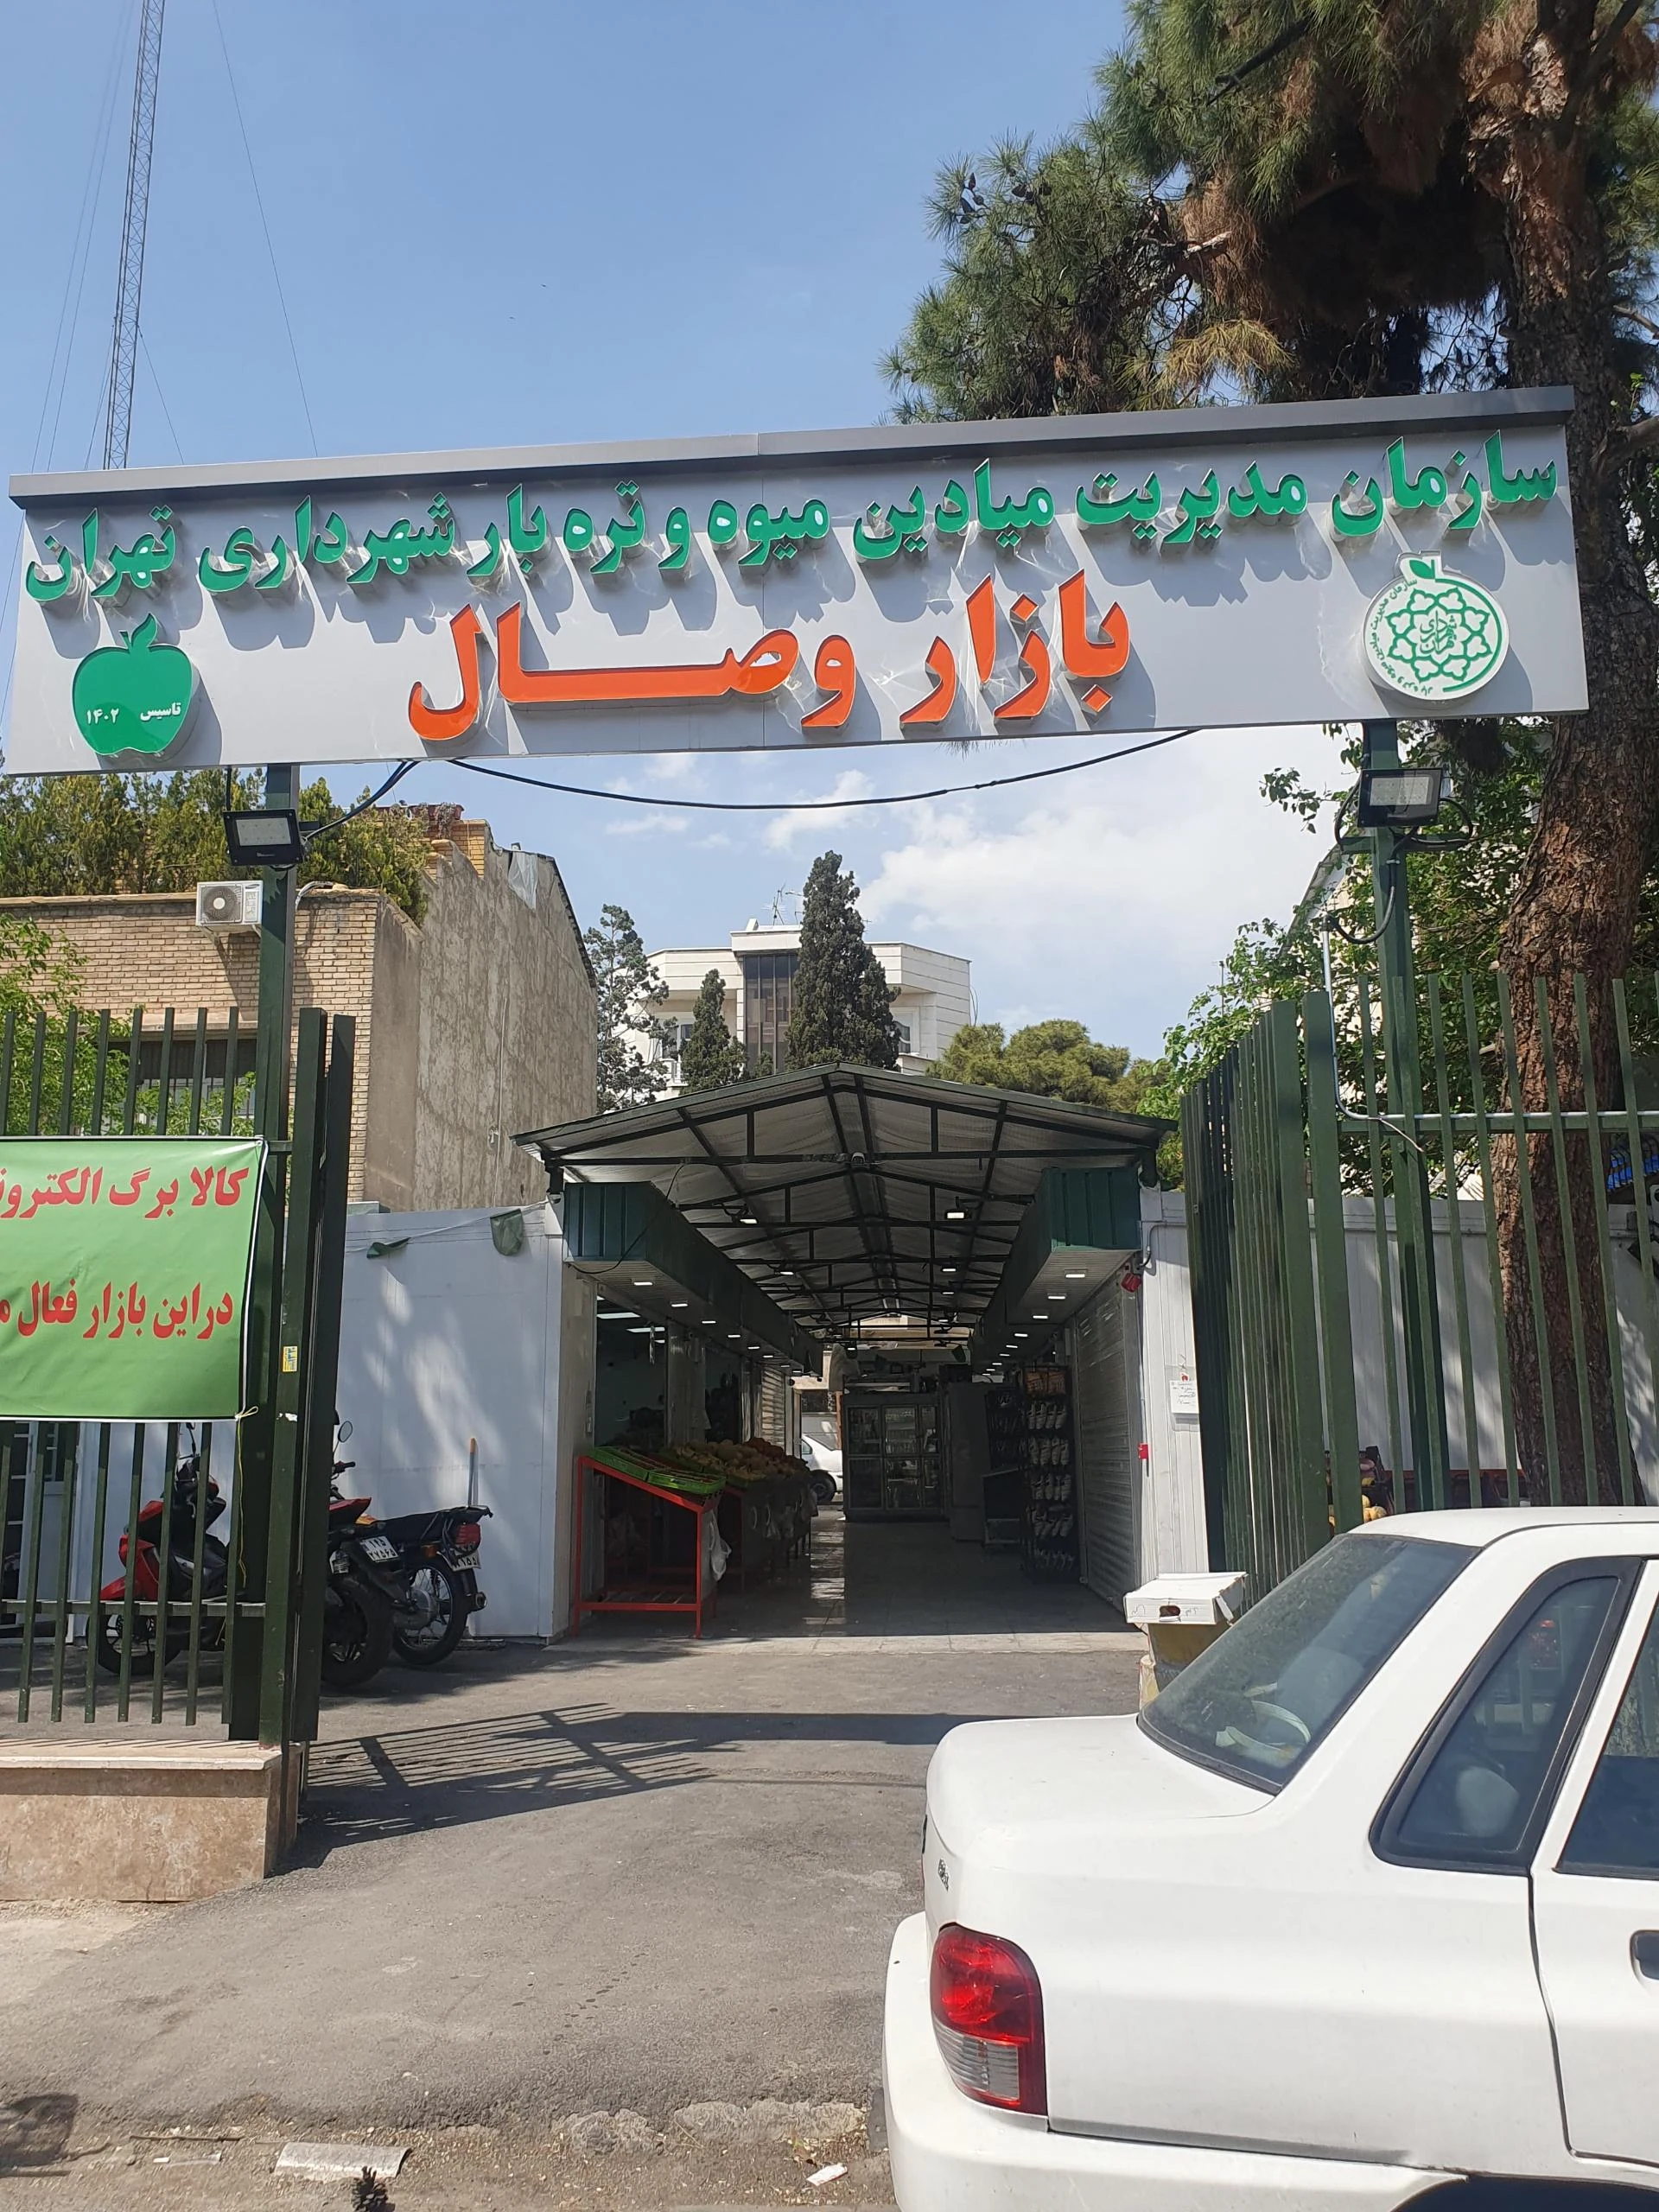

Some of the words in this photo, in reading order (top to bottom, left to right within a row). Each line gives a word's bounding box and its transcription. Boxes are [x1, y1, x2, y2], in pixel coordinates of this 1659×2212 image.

[851, 459, 1056, 563] میادین
[1074, 460, 1309, 546] مدیریت
[1330, 429, 1559, 538] سازمان
[23, 505, 177, 602] تهران
[196, 491, 456, 593] شهرداری
[657, 506, 692, 569] و
[705, 499, 831, 567] میوه
[1370, 598, 1389, 629] مدیریت
[1389, 579, 1417, 600] سازمان
[408, 601, 856, 742] وصال
[899, 569, 1130, 721] بازار
[86, 709, 118, 723] ۱۴۰۲
[140, 702, 181, 721] تاسیس
[106, 1167, 180, 1221] برگ
[188, 1166, 251, 1208] کالا
[16, 1279, 79, 1338] فعال
[81, 1281, 148, 1340] بازار
